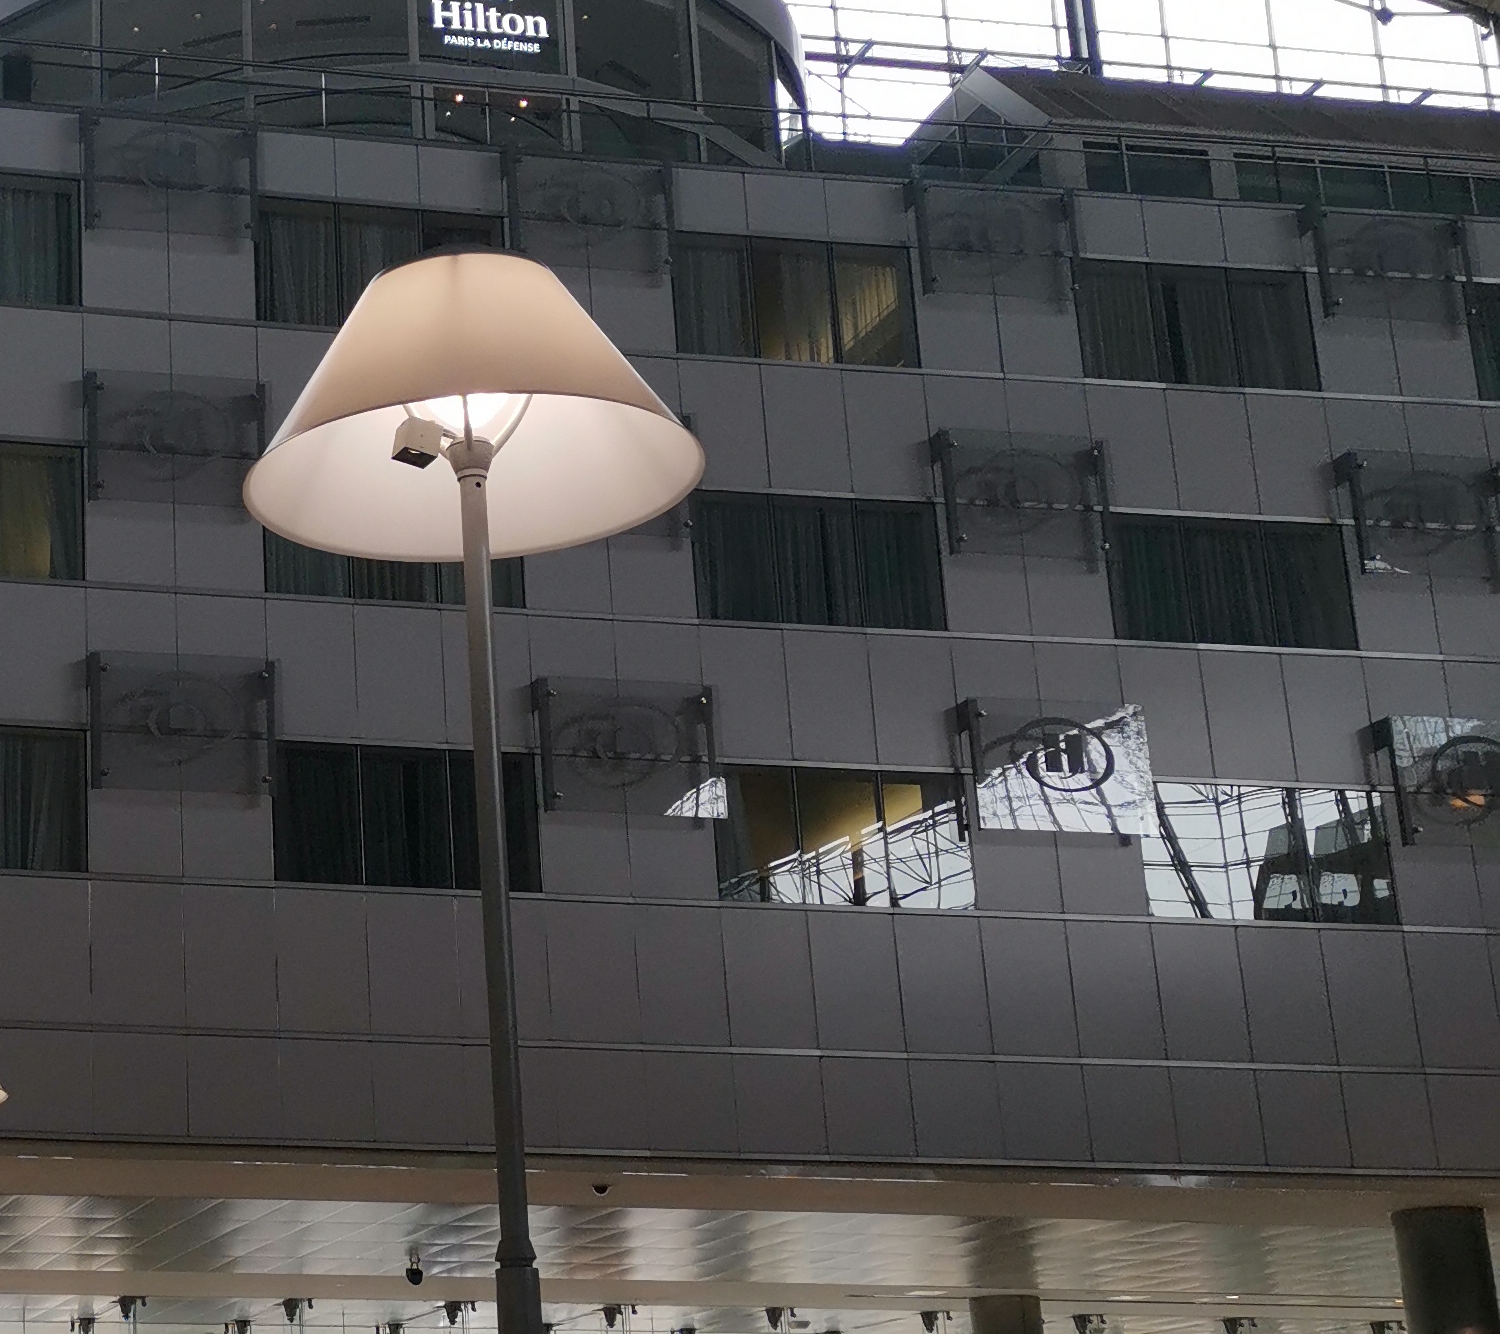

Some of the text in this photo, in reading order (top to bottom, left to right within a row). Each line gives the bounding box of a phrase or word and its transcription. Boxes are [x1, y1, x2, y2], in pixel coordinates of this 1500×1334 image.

[431, 0, 550, 39] Hilton
[443, 34, 541, 53] PARIS LA DÉFENSE
